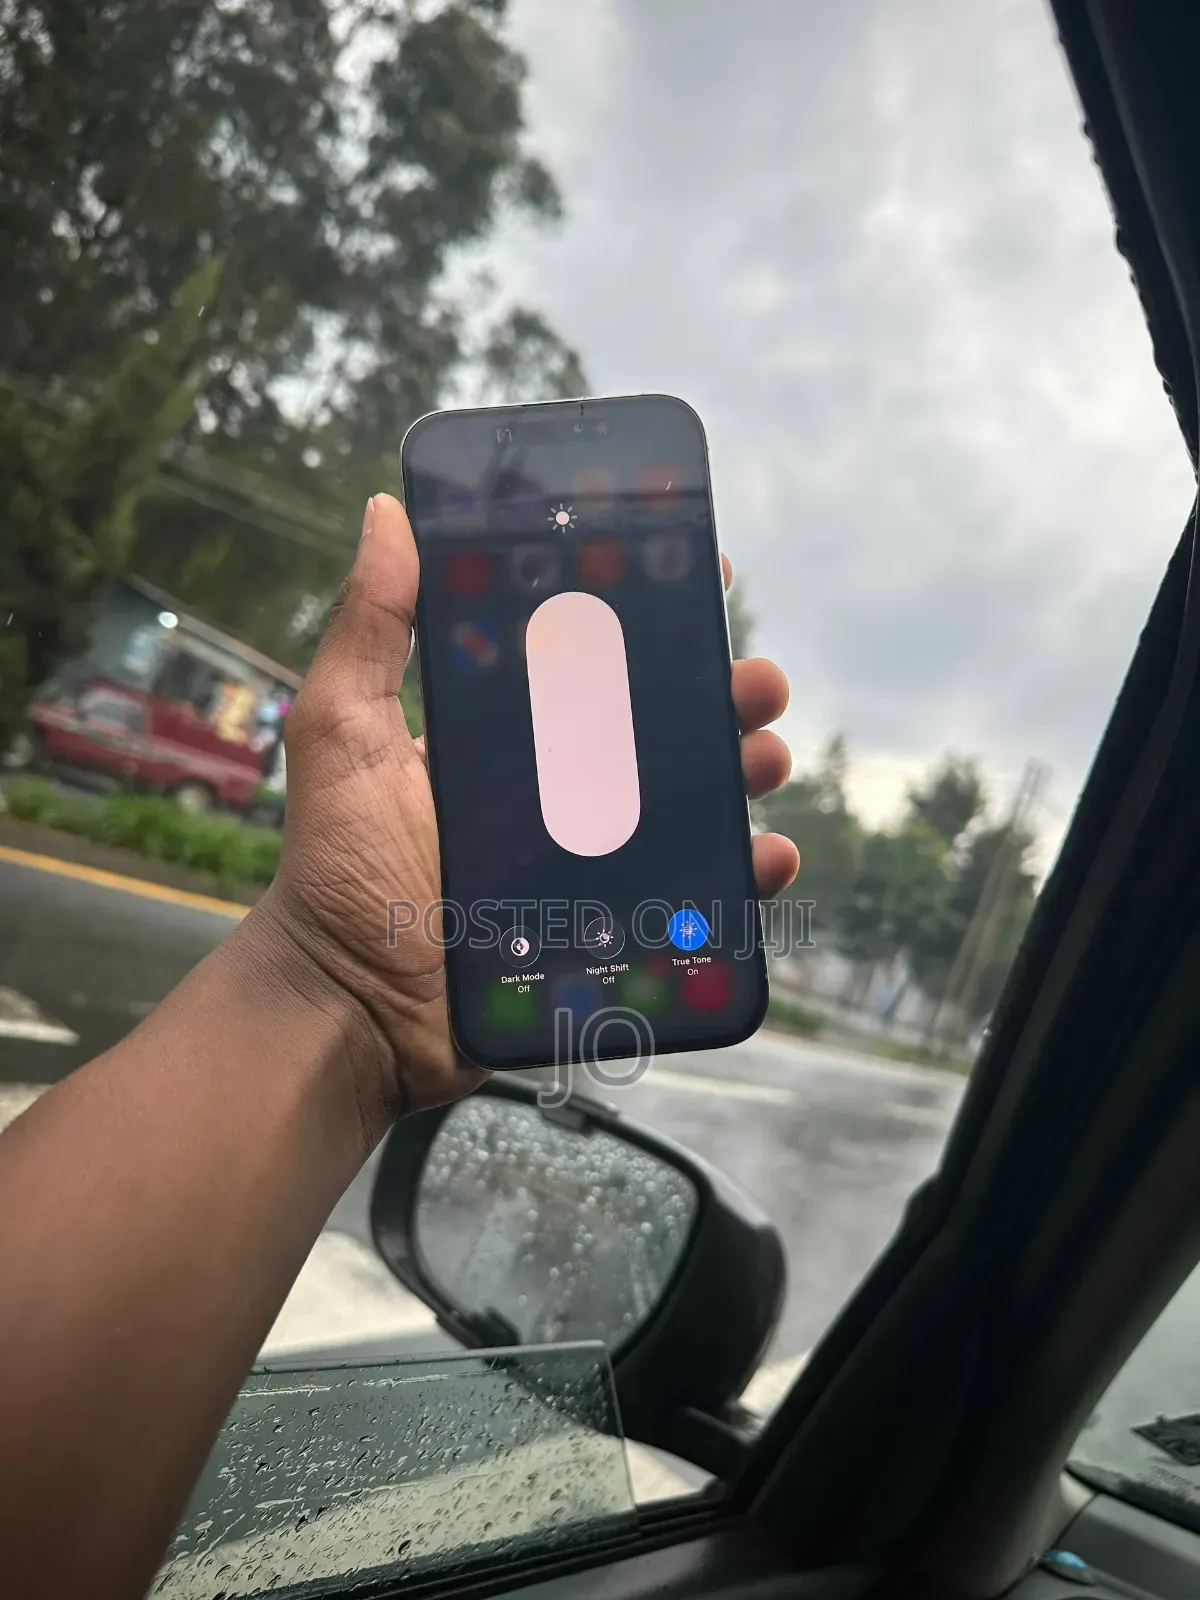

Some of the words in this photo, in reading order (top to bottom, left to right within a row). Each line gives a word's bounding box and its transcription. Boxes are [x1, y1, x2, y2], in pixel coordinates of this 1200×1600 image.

[672, 958, 690, 966] True
[693, 956, 712, 965] Tone
[586, 966, 608, 977] Night
[610, 963, 630, 972] Shift
[687, 968, 698, 976] On
[501, 975, 521, 984] Dark
[522, 972, 545, 982] Mode
[602, 975, 615, 985] Off
[517, 984, 530, 993] Off
